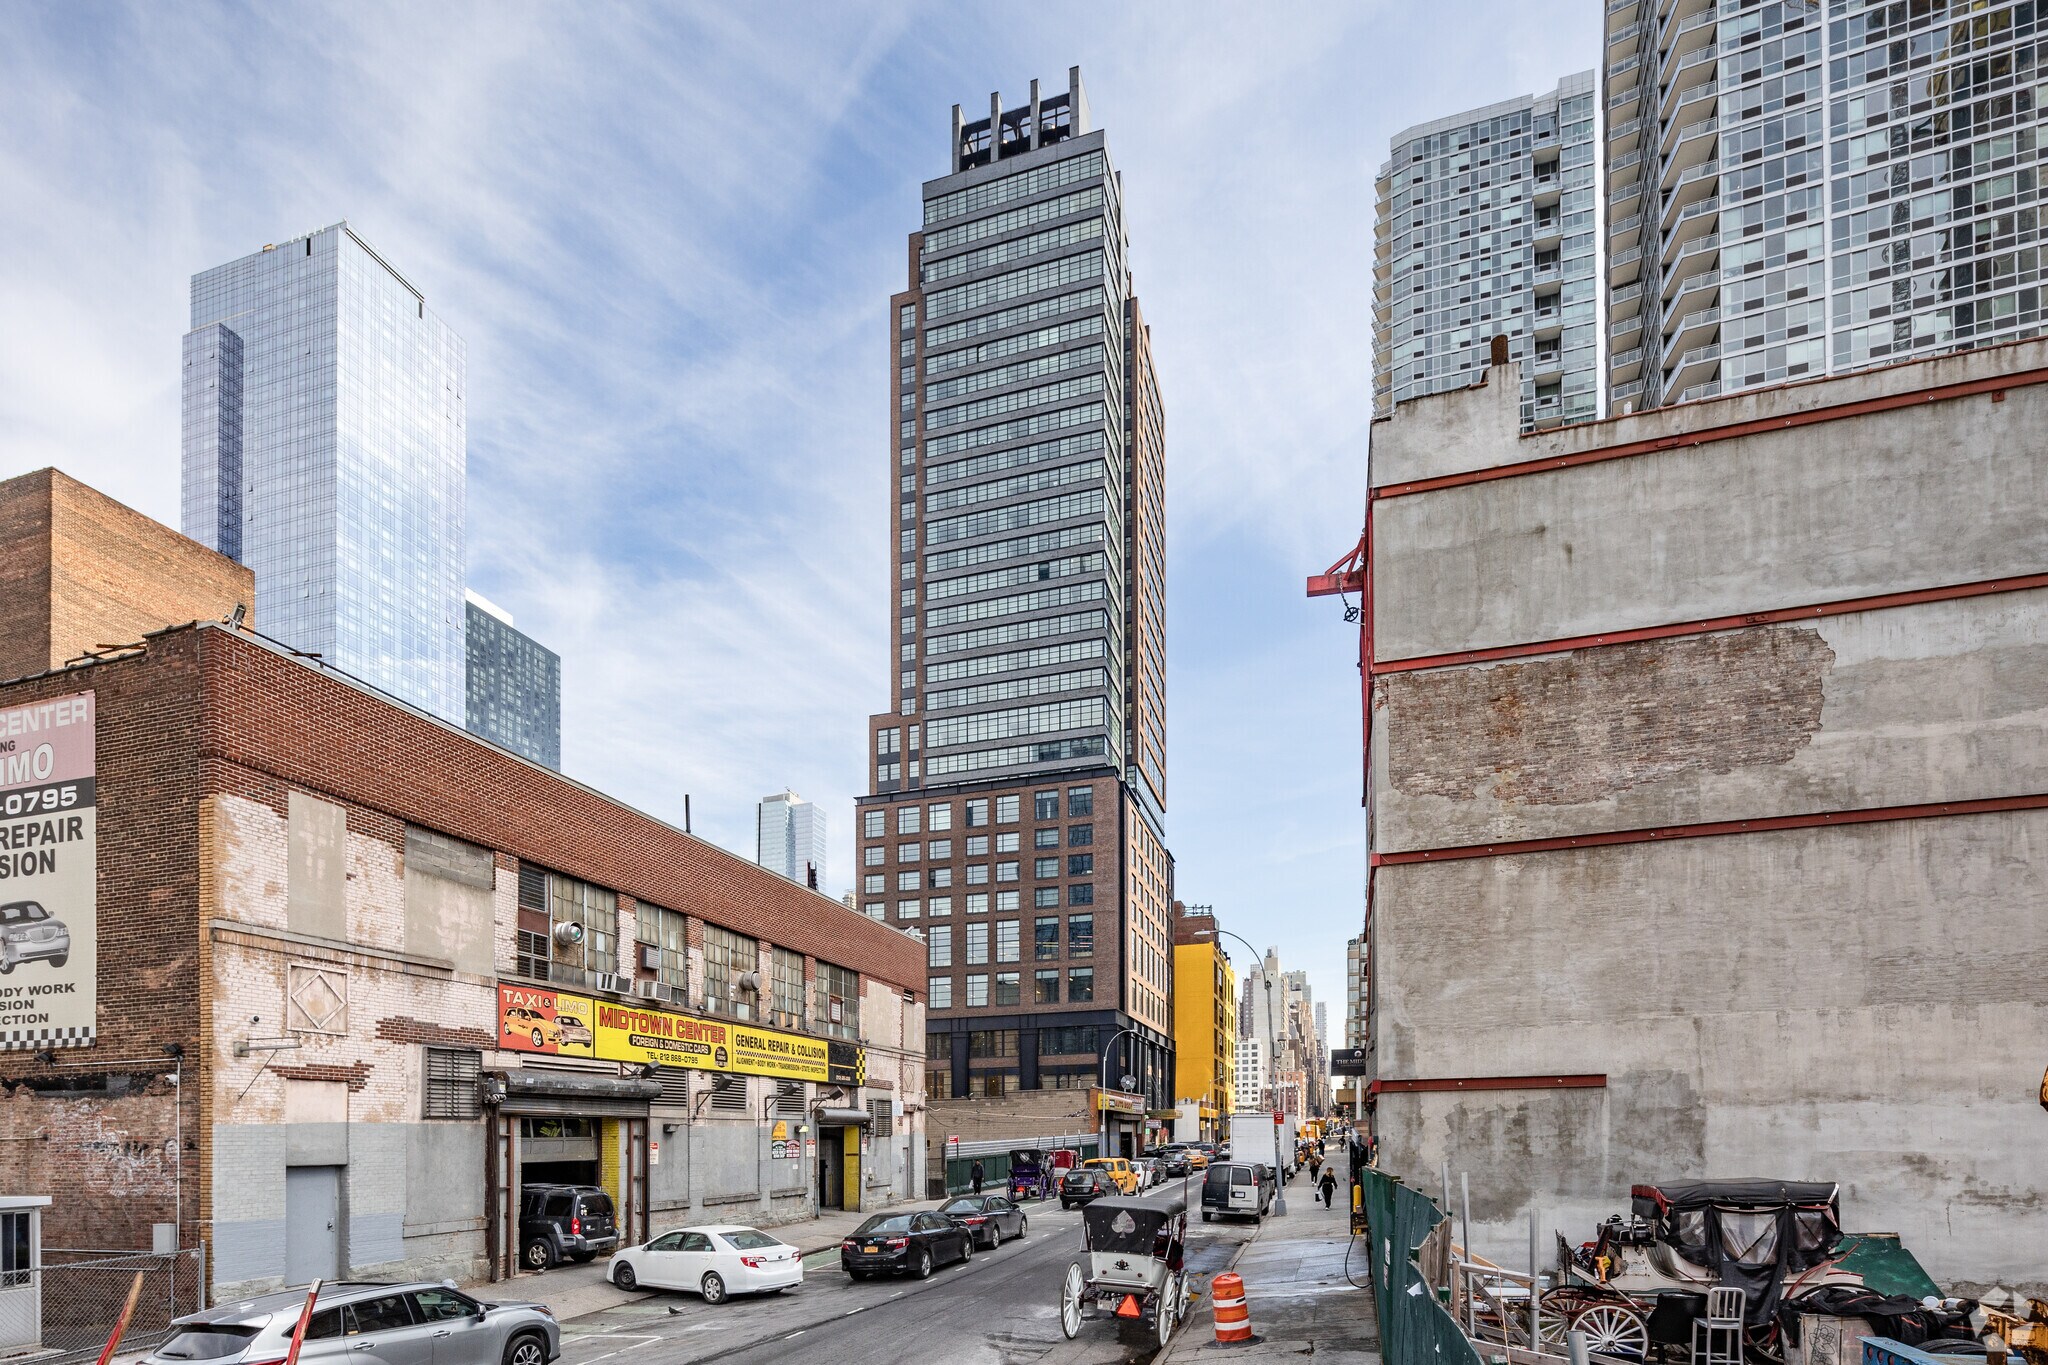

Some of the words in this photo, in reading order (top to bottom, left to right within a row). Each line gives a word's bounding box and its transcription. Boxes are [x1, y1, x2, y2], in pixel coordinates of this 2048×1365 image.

[0, 816, 84, 850] REPAIR
[28, 983, 76, 996] WORK
[503, 989, 542, 1008] TAXI
[543, 998, 551, 1008] &
[553, 997, 588, 1015] LIMO
[0, 1012, 49, 1025] CTION
[599, 1005, 673, 1037] MIDTOWN
[675, 1019, 726, 1045] CENTER
[632, 1035, 659, 1049] FOREIGN
[664, 1040, 694, 1053] DOMESTIC
[694, 1043, 709, 1055] CARS
[735, 1033, 767, 1051] GENERAL
[768, 1039, 790, 1055] REPAIR
[791, 1043, 796, 1055] &
[797, 1044, 826, 1060] COLLISION
[646, 1051, 659, 1060] TEL:
[660, 1053, 670, 1061] 212
[736, 1057, 755, 1067] ALIGNMENT
[757, 1059, 766, 1067] BODY
[767, 1060, 776, 1069] WORK
[778, 1062, 800, 1071] TRANSMISSION
